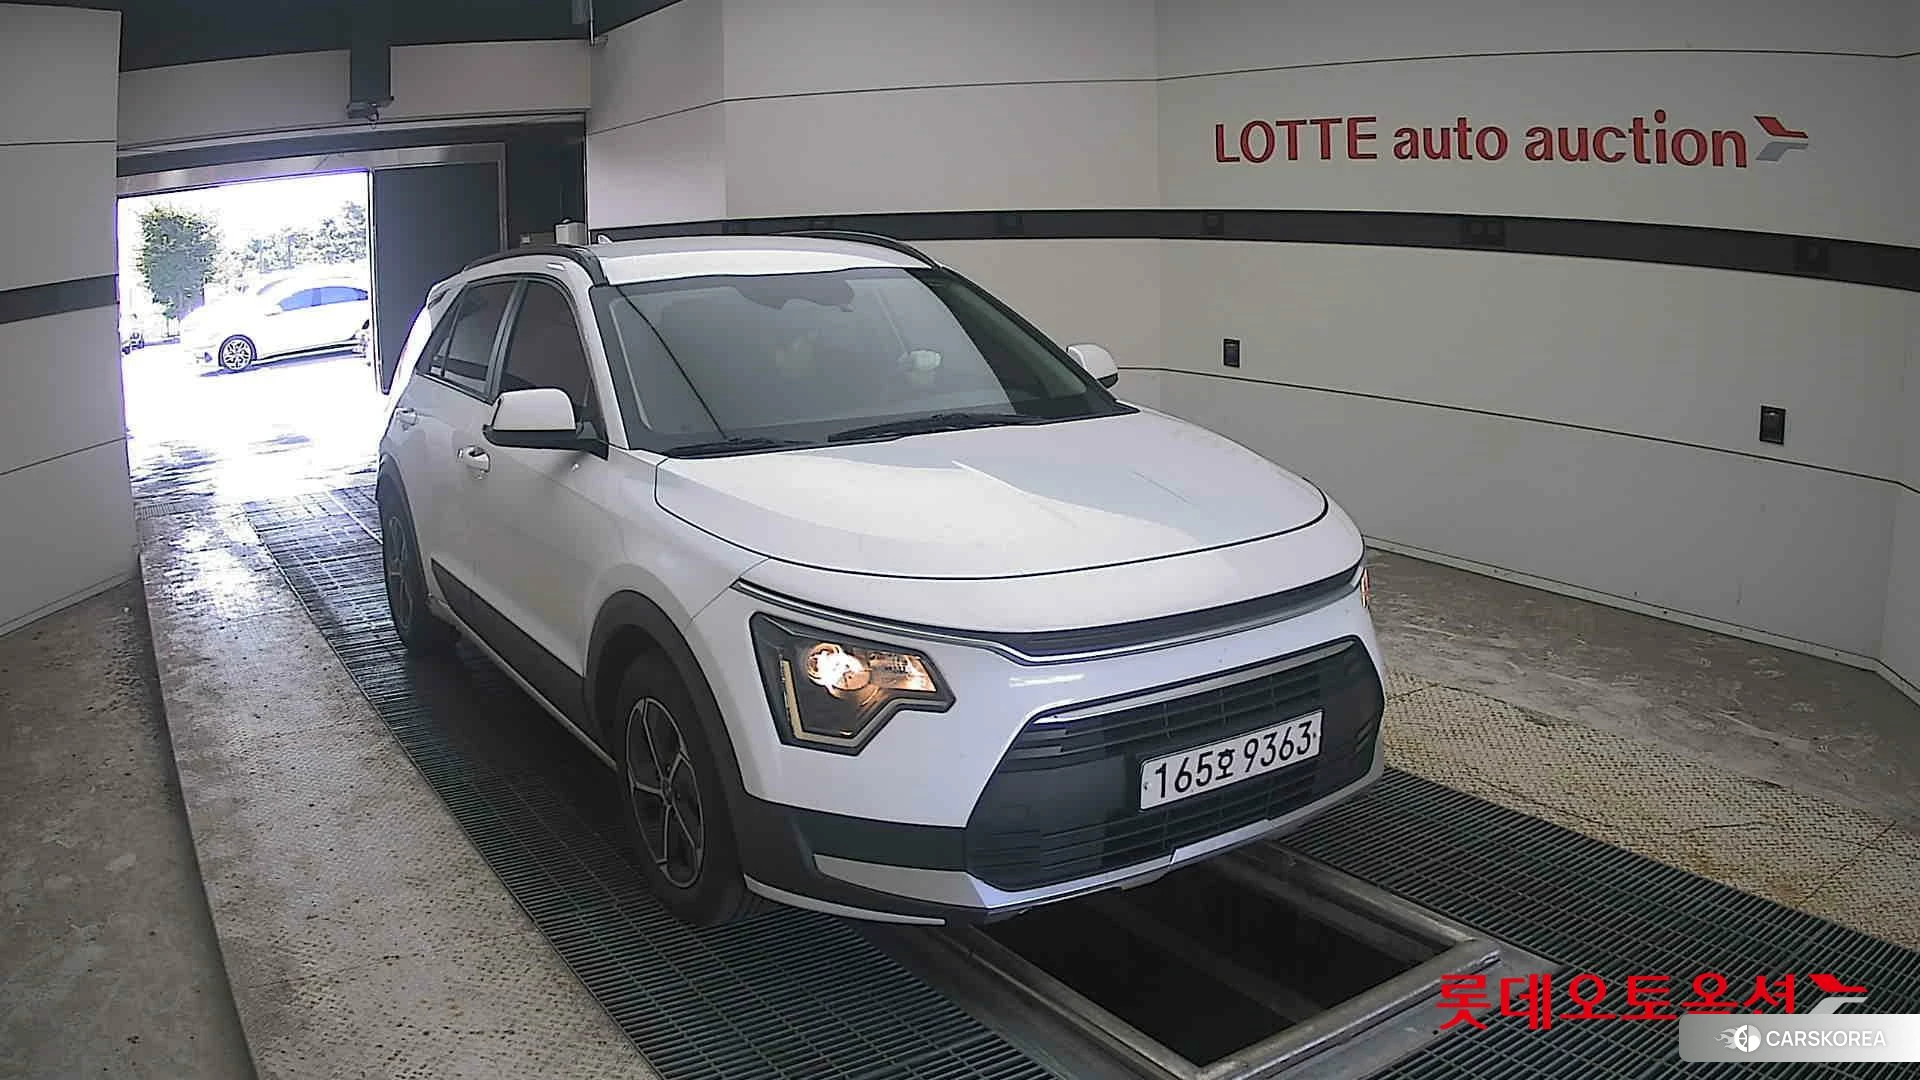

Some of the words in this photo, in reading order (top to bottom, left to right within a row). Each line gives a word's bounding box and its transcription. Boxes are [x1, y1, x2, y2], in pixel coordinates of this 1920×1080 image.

[1215, 116, 1377, 164] LOTTE
[1392, 116, 1508, 161] auto
[1524, 109, 1747, 169] auction
[1154, 748, 1236, 799] 165호
[1243, 720, 1313, 774] 9363
